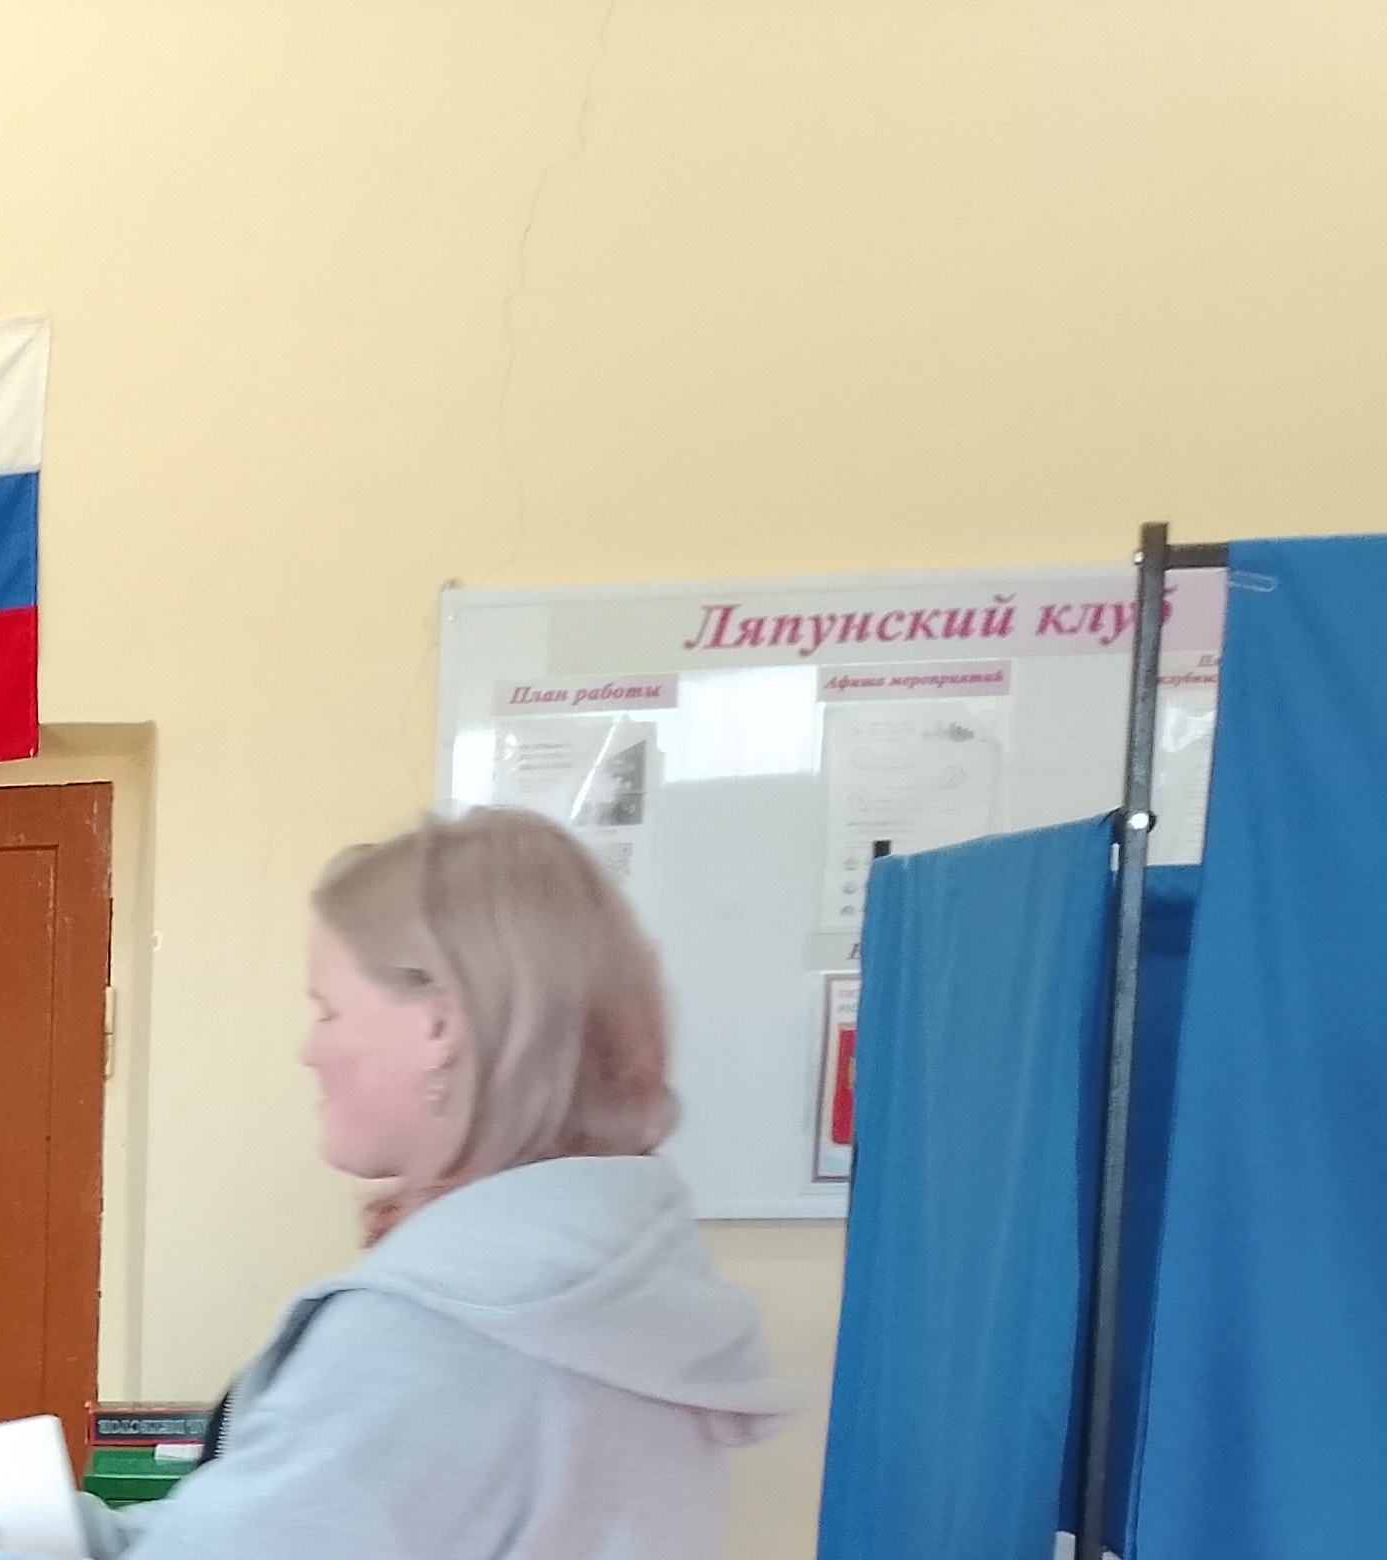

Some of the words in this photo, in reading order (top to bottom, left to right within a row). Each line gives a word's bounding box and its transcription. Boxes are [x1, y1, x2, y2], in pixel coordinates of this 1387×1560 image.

[683, 593, 1018, 657] Ляпунский
[510, 686, 568, 704] План
[571, 682, 662, 706] работы
[824, 674, 886, 691] Афиша
